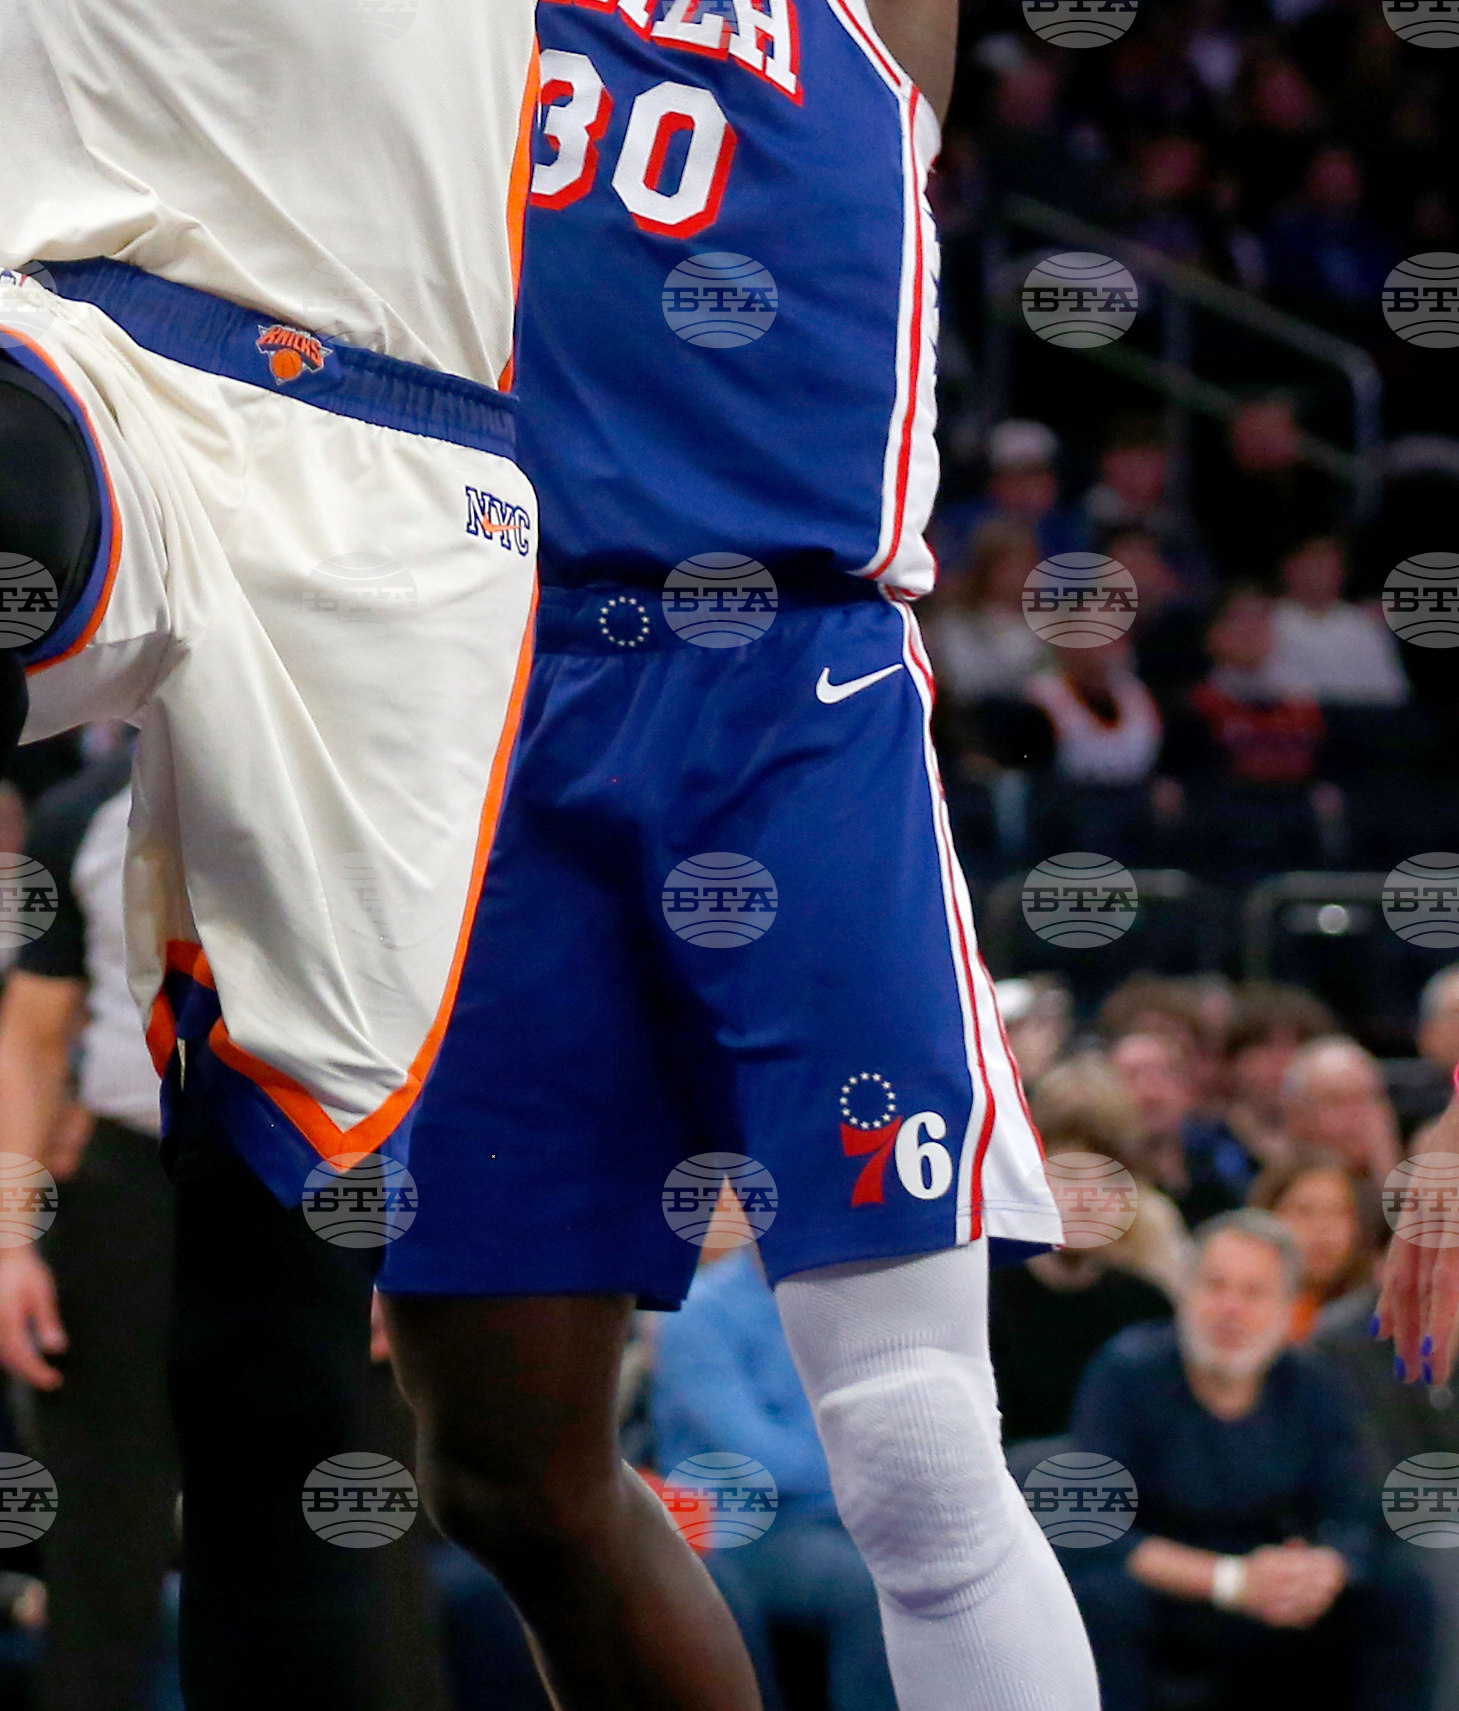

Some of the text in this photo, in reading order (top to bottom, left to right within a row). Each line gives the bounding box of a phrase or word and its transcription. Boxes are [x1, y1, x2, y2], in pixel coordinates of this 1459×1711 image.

[531, 49, 737, 238] 30
[465, 485, 530, 557] NYC
[840, 1110, 953, 1208] 76
